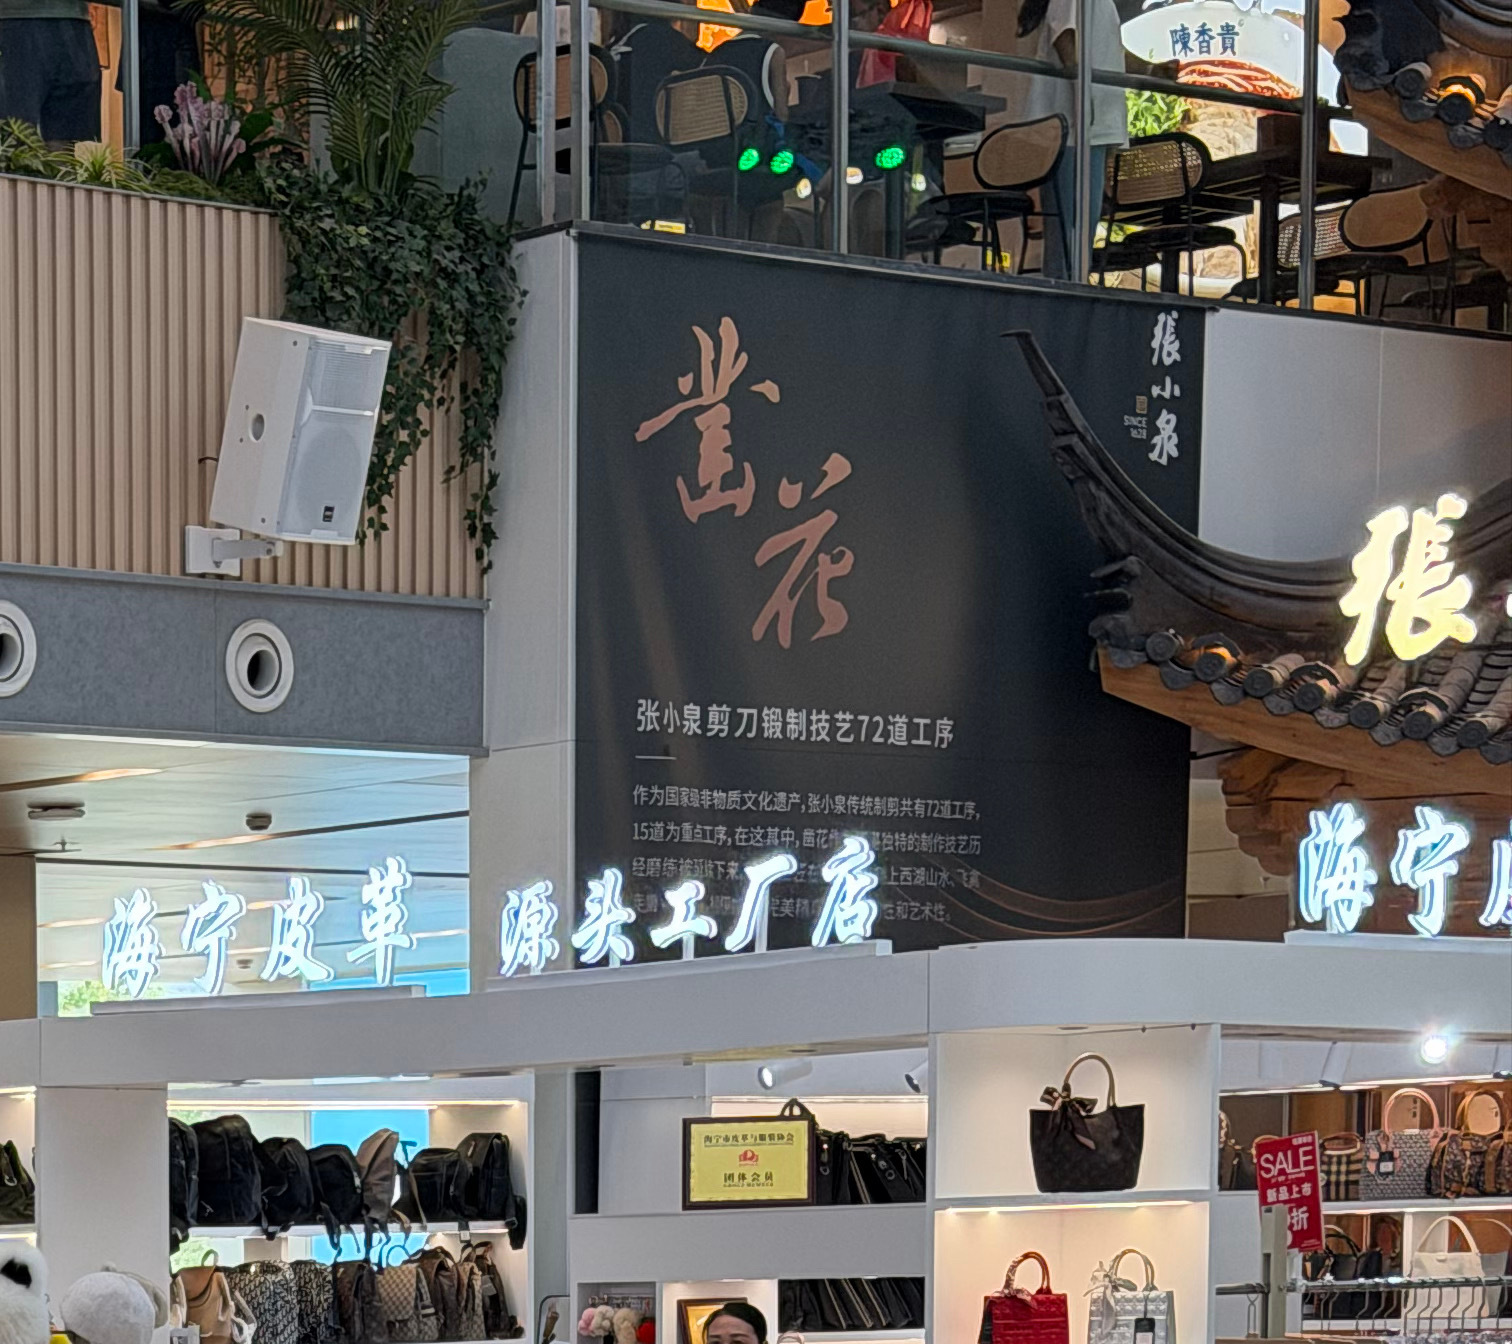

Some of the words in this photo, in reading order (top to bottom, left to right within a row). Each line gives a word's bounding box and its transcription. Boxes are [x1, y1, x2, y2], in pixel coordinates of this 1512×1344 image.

[1169, 22, 1240, 57] 陳香貴
[1124, 415, 1148, 428] SINCE
[1339, 493, 1512, 666] 張
[636, 698, 954, 749] 张小泉剪刀锻制技艺72道工序
[1298, 802, 1512, 938] 海宁
[101, 855, 417, 998] 海宁皮革
[500, 836, 879, 977] 源头工厂店
[1260, 1146, 1315, 1178] SALE
[1266, 1182, 1312, 1203] 新品上市
